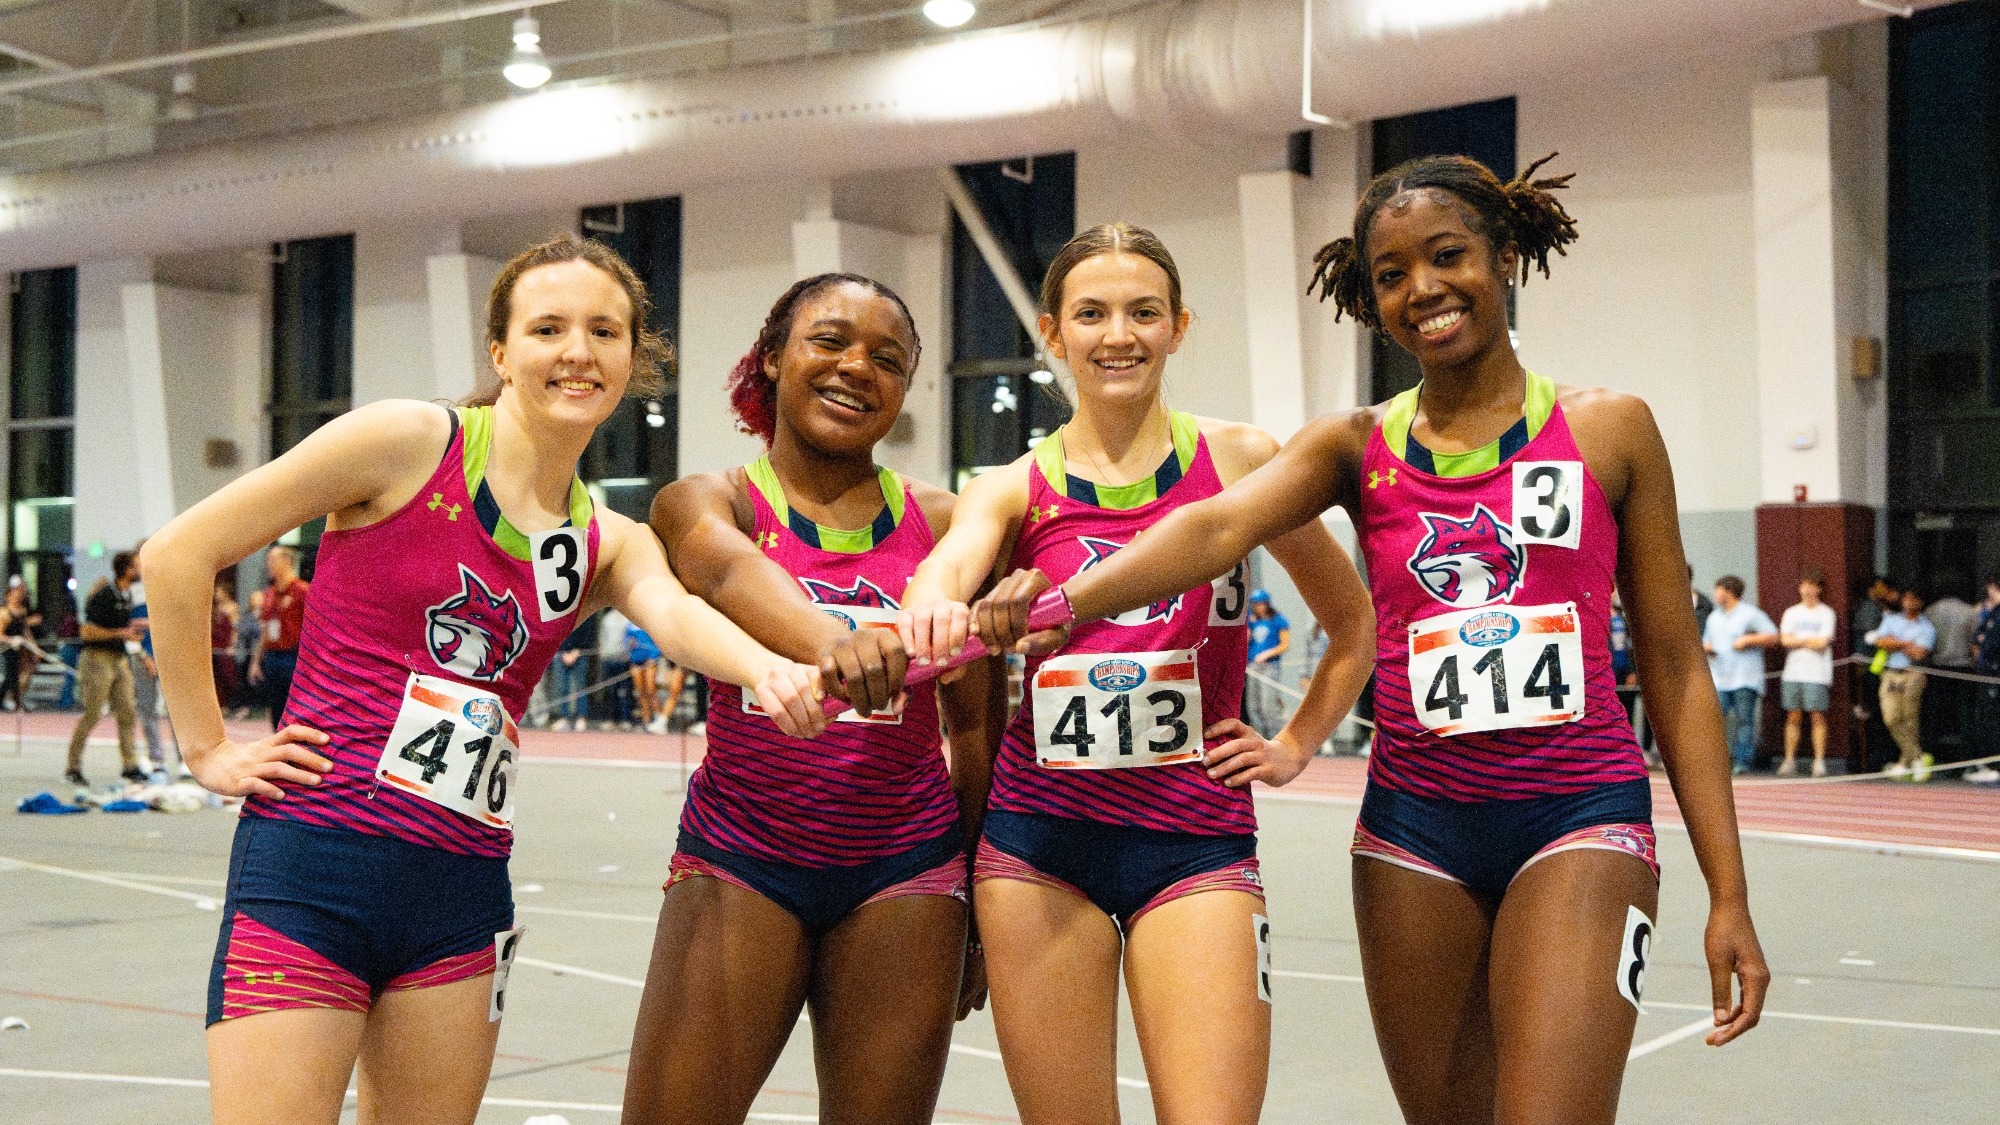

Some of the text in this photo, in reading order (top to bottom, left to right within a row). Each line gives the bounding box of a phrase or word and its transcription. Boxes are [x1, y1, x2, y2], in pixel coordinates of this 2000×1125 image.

[1521, 466, 1570, 538] 3
[540, 534, 580, 612] 3
[1216, 561, 1245, 620] 3
[1425, 643, 1570, 720] 414
[1050, 690, 1188, 757] 413
[399, 719, 511, 814] 416
